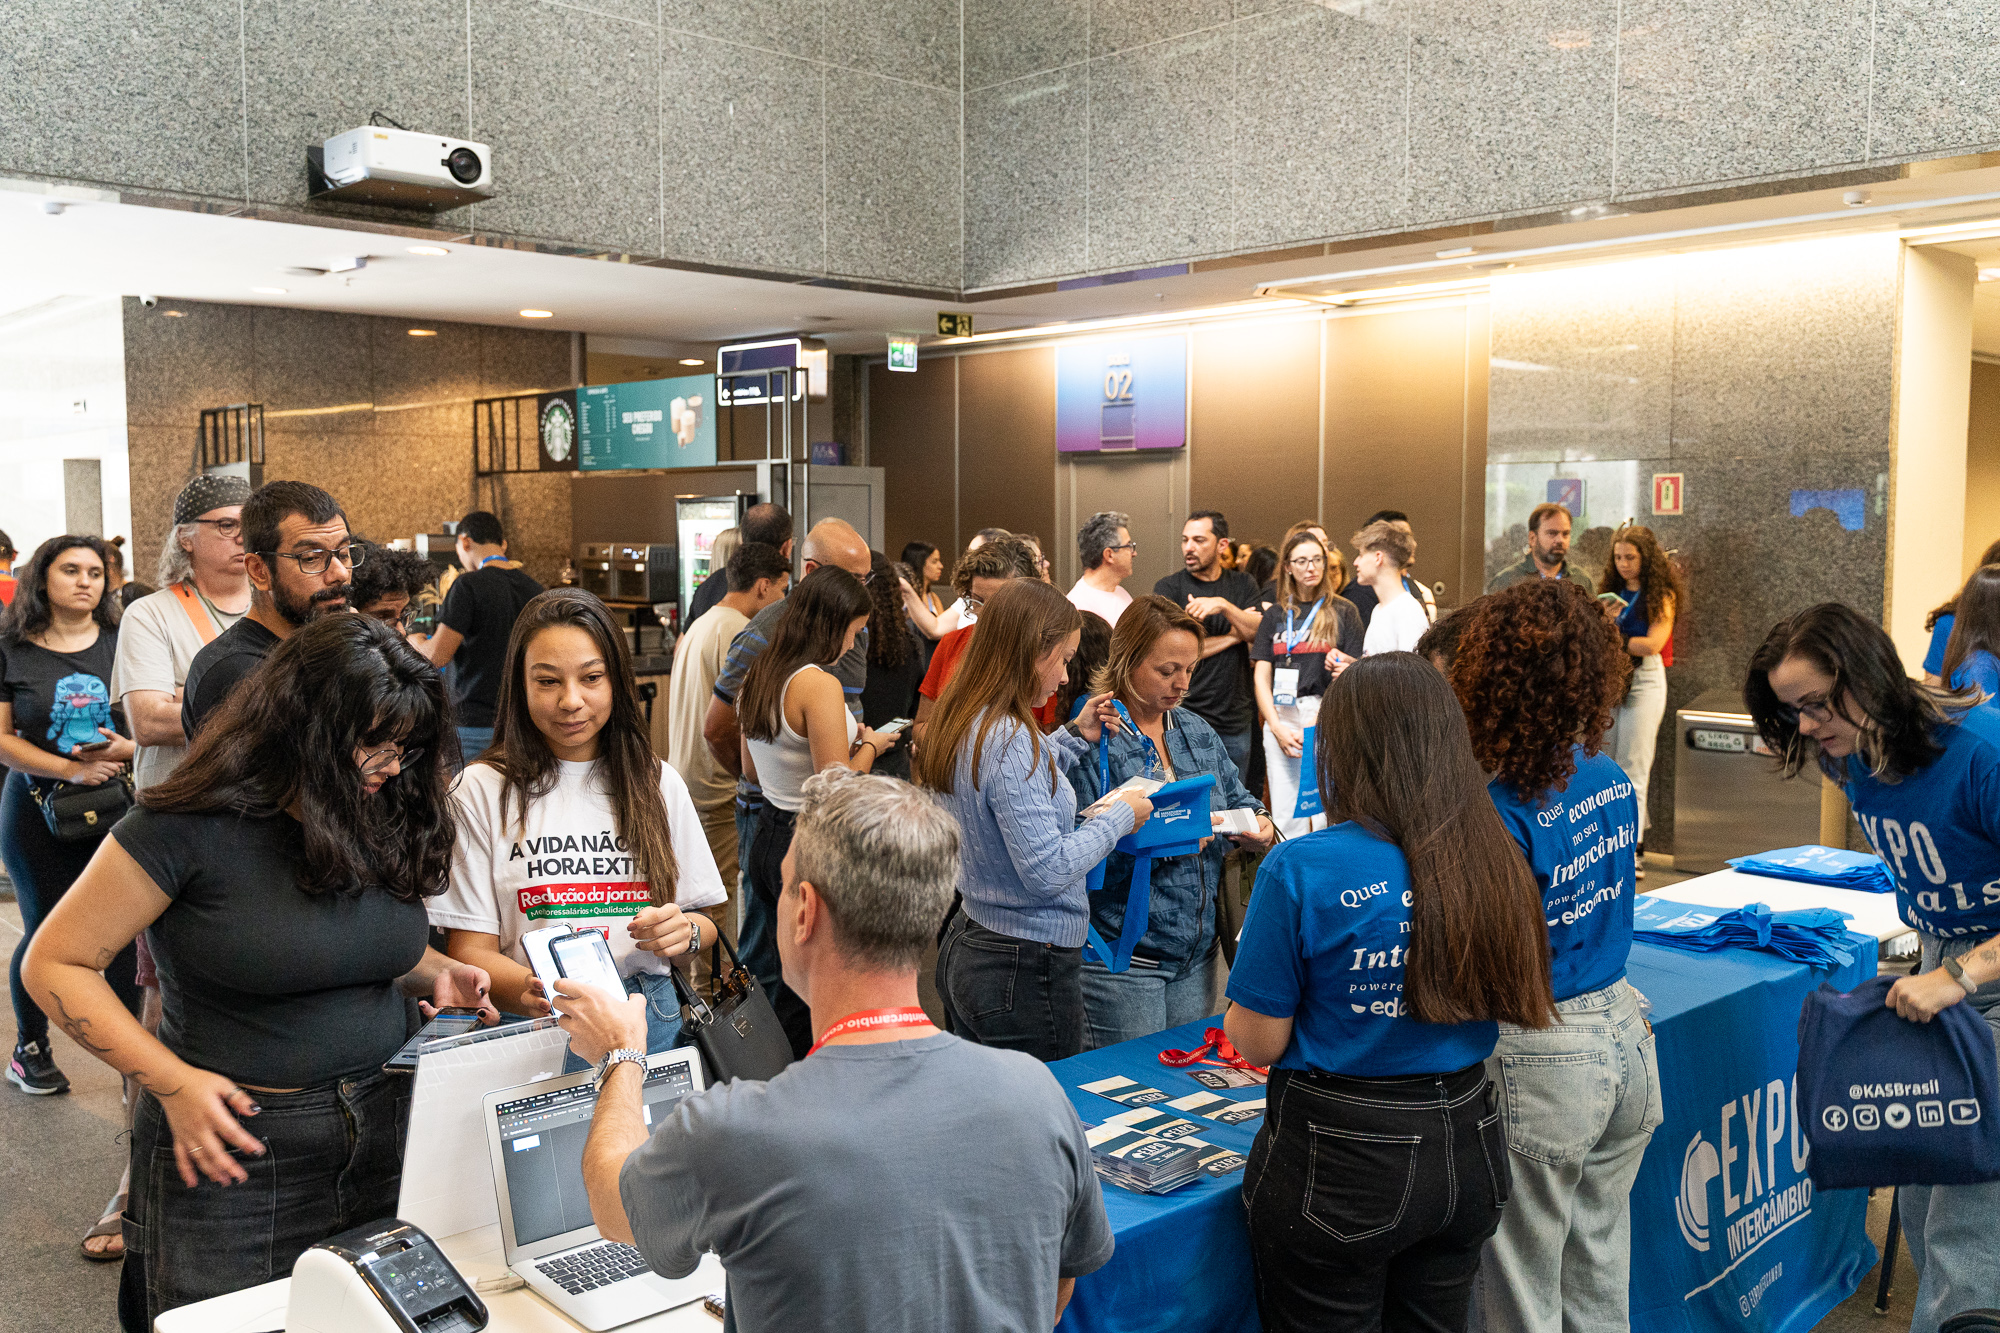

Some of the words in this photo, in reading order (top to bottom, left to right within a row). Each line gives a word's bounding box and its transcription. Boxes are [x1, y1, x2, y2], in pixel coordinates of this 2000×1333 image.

[1104, 370, 1133, 400] 02
[1537, 801, 1565, 828] Quer
[509, 842, 525, 861] A
[526, 835, 580, 856] VIDA
[581, 830, 631, 853] NÃO
[1572, 832, 1583, 847] no
[527, 857, 590, 879] HORA
[520, 887, 587, 908] Redução
[587, 886, 605, 902] da
[1340, 880, 1389, 908] Quer
[561, 906, 590, 916] salários
[593, 905, 634, 915] Qualidade
[1850, 1079, 1940, 1100] @KASBrasil
[1170, 1123, 1196, 1137] EXPO
[1141, 1142, 1168, 1158] EXPO
[1721, 1072, 1810, 1218] EXPO
[1217, 1156, 1243, 1169] EXPO
[1727, 1177, 1813, 1260] INTERCÂMBIO
